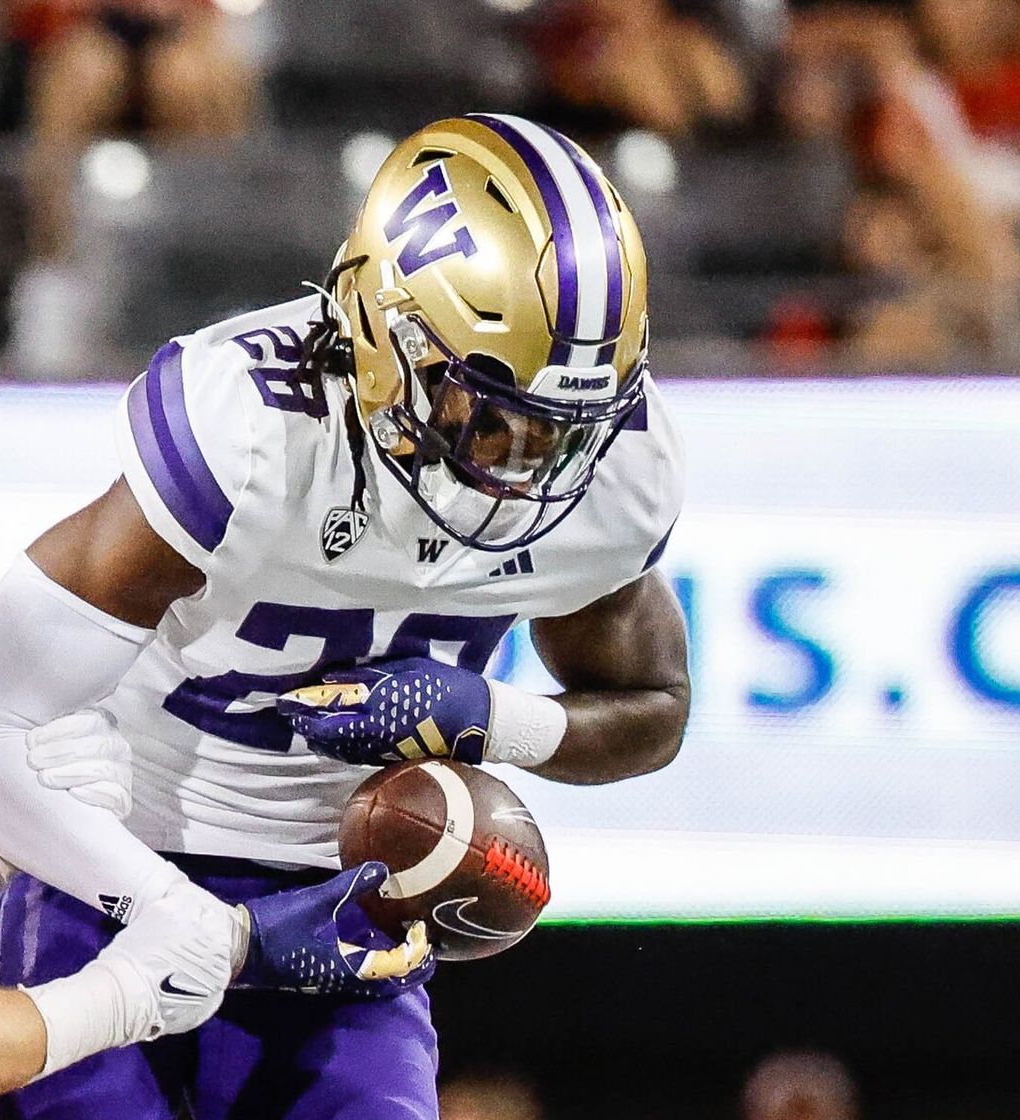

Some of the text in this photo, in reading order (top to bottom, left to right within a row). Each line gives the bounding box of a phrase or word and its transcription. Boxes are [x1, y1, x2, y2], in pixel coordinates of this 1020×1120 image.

[383, 160, 478, 277] W
[232, 326, 330, 418] 28
[323, 509, 369, 544] PAC
[325, 531, 356, 552] 12
[417, 539, 449, 563] W
